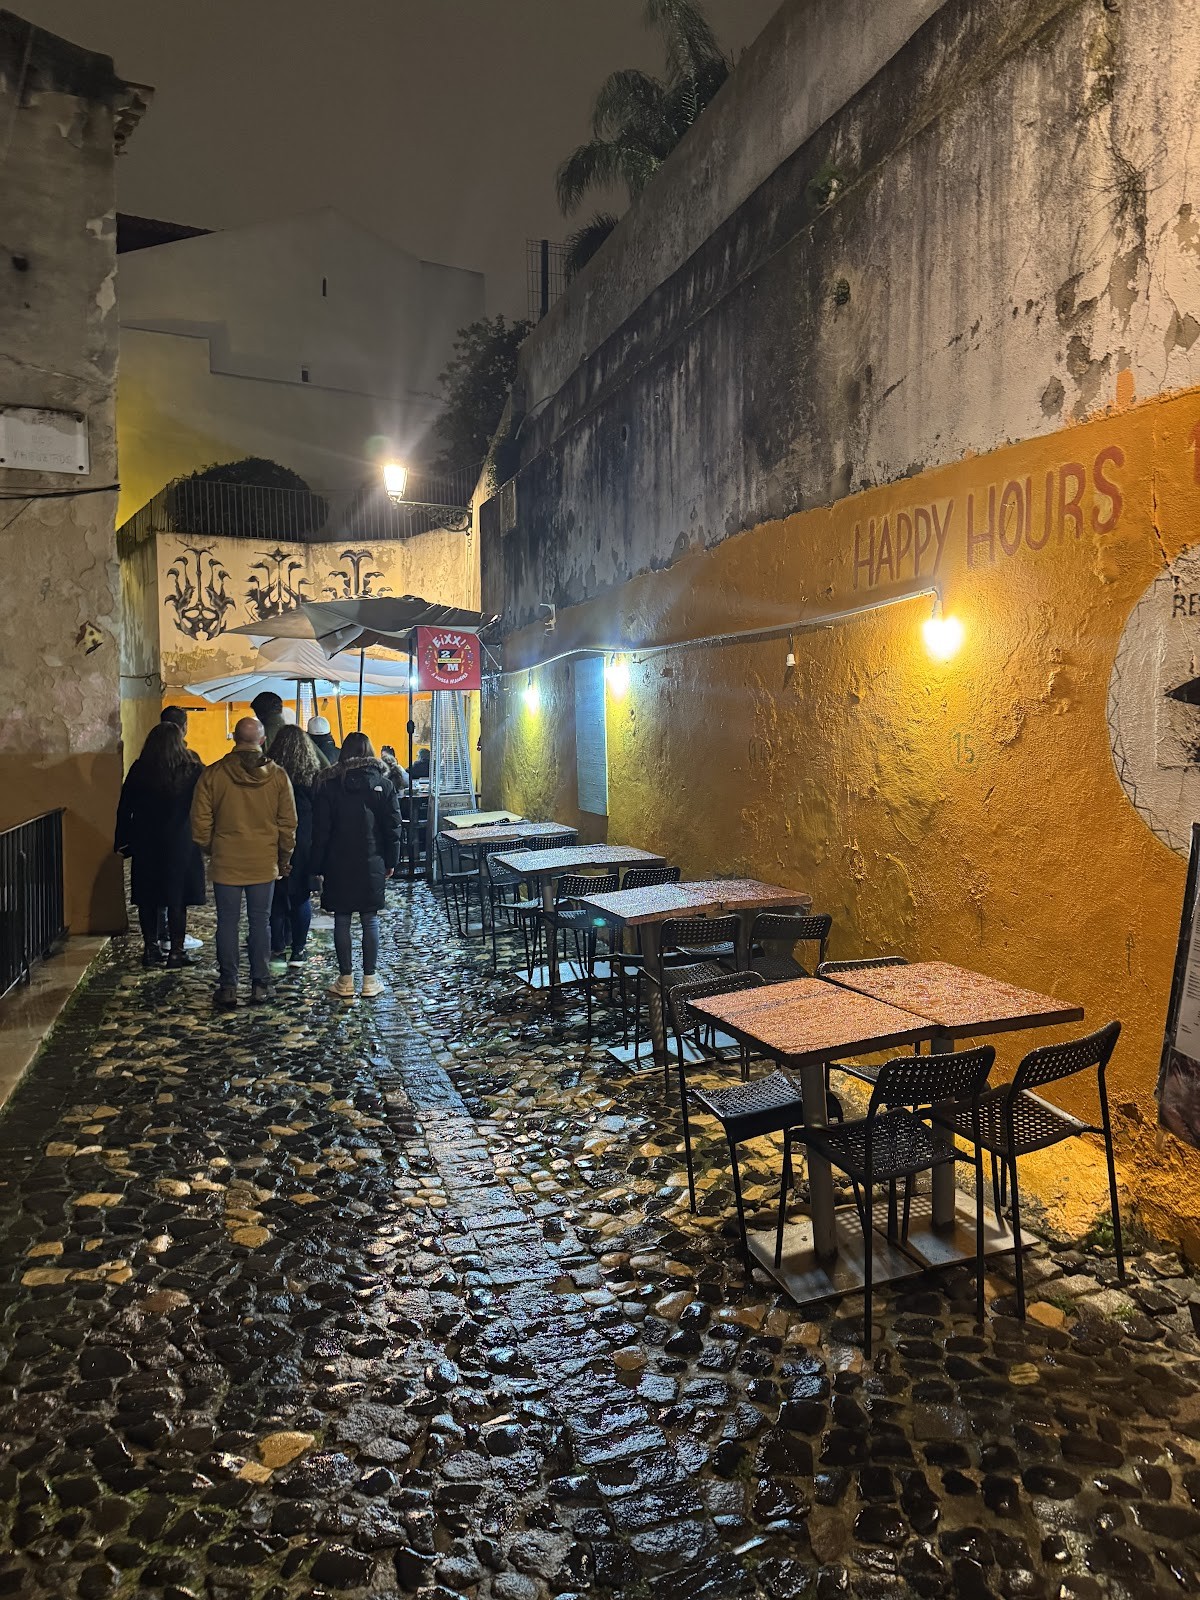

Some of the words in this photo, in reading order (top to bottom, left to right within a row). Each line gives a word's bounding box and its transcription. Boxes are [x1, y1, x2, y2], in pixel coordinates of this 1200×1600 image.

[852, 498, 954, 591] HAPPY
[967, 445, 1125, 570] HOURS
[1172, 593, 1200, 619] RE
